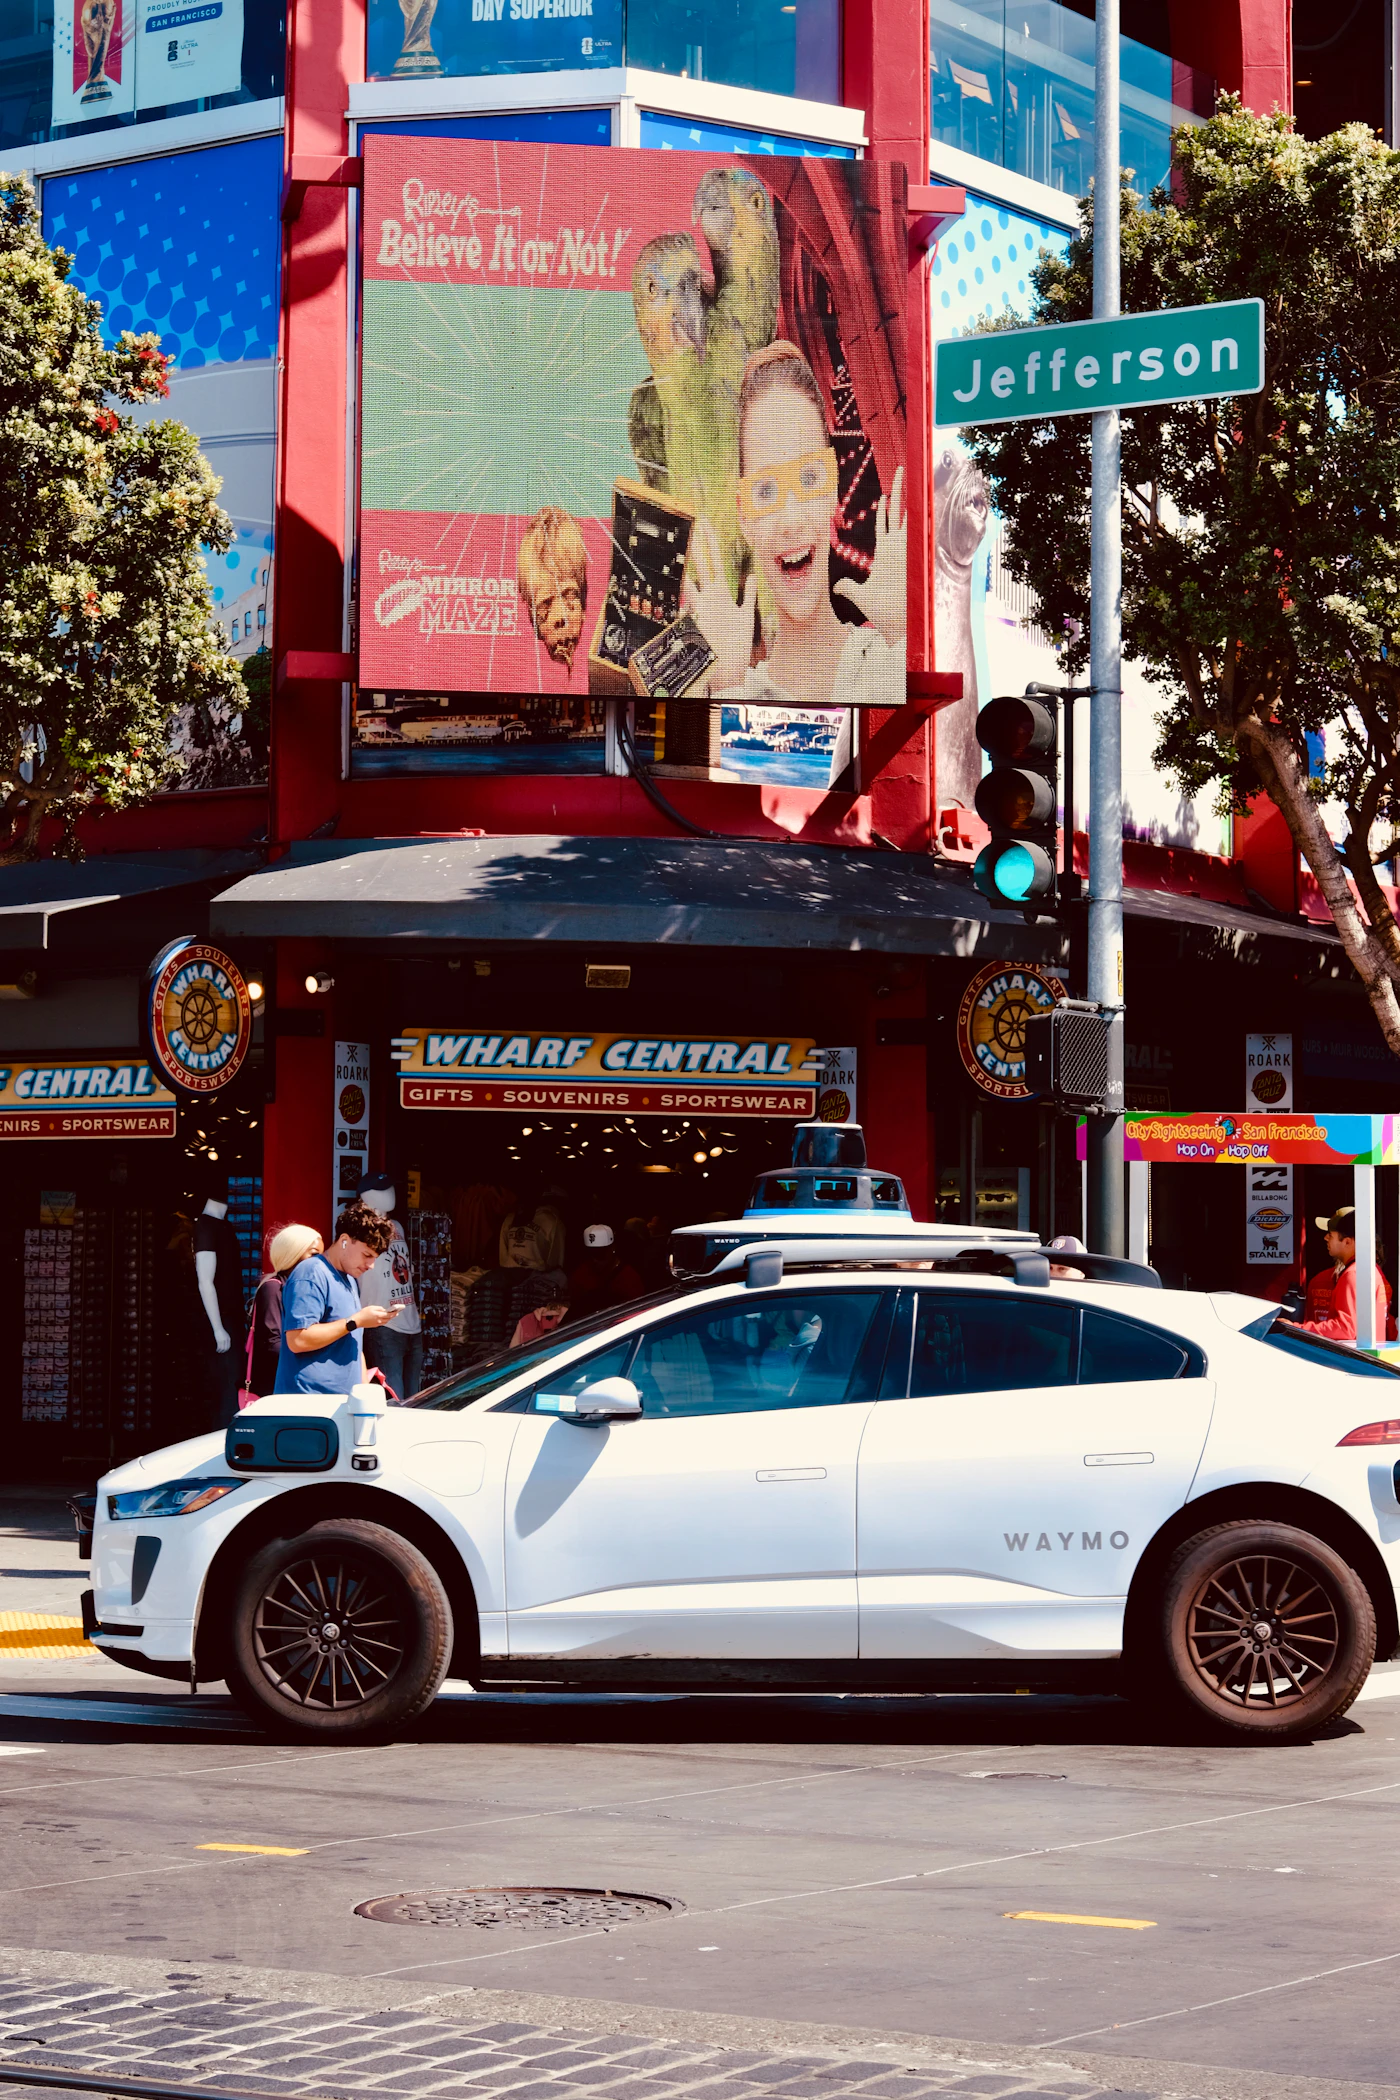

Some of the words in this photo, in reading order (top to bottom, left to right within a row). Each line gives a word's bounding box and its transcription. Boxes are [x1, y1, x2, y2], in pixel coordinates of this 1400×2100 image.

[147, 1, 179, 12] PROUDLY
[151, 19, 168, 28] SAN
[171, 7, 217, 24] FRANCISCO
[472, 0, 506, 22] DAY
[510, 0, 593, 20] SUPERIOR
[376, 219, 483, 270] Believe
[489, 223, 517, 273] It
[522, 239, 554, 274] or
[558, 227, 628, 278] Not!
[952, 337, 1239, 403] Jefferson
[421, 576, 517, 597] MIRROR
[419, 597, 520, 635] MAZE
[156, 960, 179, 1010] GIFTS
[170, 963, 236, 1001] WHARF
[196, 947, 250, 1017] SOUVENIRS
[977, 964, 1054, 1010] WHARF
[959, 977, 985, 1025] GIFTS
[168, 1030, 238, 1070] CENTRAL
[425, 1034, 594, 1068] WHARF
[602, 1039, 793, 1073] CENTRAL
[1248, 1053, 1291, 1067] ROARK
[162, 1051, 242, 1089] SPORTSWEAR
[336, 1064, 369, 1082] ROARK
[822, 1070, 855, 1085] OARK
[14, 1066, 156, 1098] CENTRAL
[1251, 1072, 1283, 1092] SANTA
[1257, 1083, 1282, 1101] CRUZ
[339, 1087, 362, 1109] SANTA
[408, 1088, 474, 1102] GIFTS
[503, 1090, 630, 1106] SOUVENIRS
[660, 1093, 807, 1110] SPORTSWEAR
[343, 1101, 362, 1120] CRUZ
[62, 1118, 170, 1132] SPORTSWEAR
[1242, 1122, 1267, 1140] San
[1268, 1122, 1328, 1141] Francisco
[1177, 1144, 1198, 1157] Hop
[1200, 1143, 1215, 1156] On
[1228, 1144, 1250, 1158] Hop
[1251, 1144, 1269, 1157] Off
[1253, 1215, 1287, 1223] Dickies
[1248, 1251, 1291, 1260] STANLEY
[1003, 1530, 1130, 1552] WAYMO
